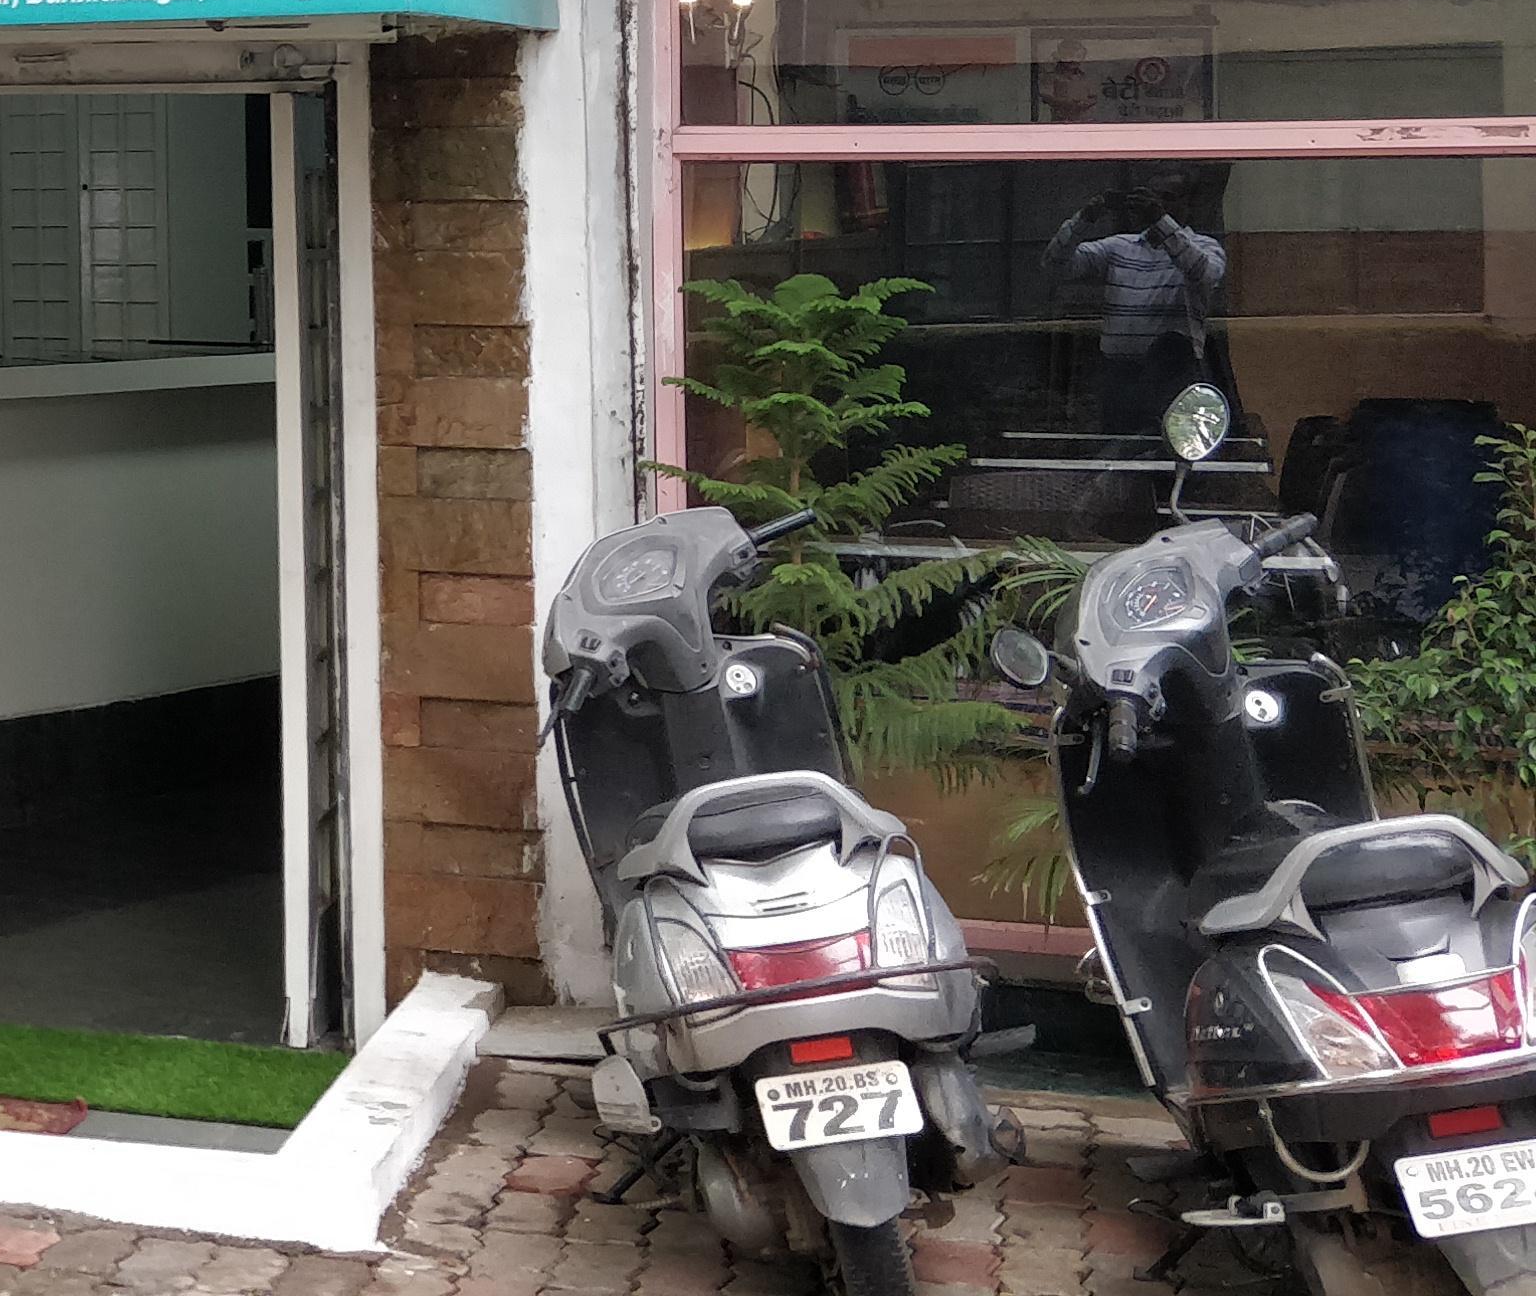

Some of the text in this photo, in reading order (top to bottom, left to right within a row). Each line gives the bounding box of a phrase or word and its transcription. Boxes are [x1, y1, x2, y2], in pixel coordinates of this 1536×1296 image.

[784, 1070, 880, 1100] MH.20.BS
[771, 1088, 903, 1142] 727
[1425, 1154, 1497, 1183] MH.20
